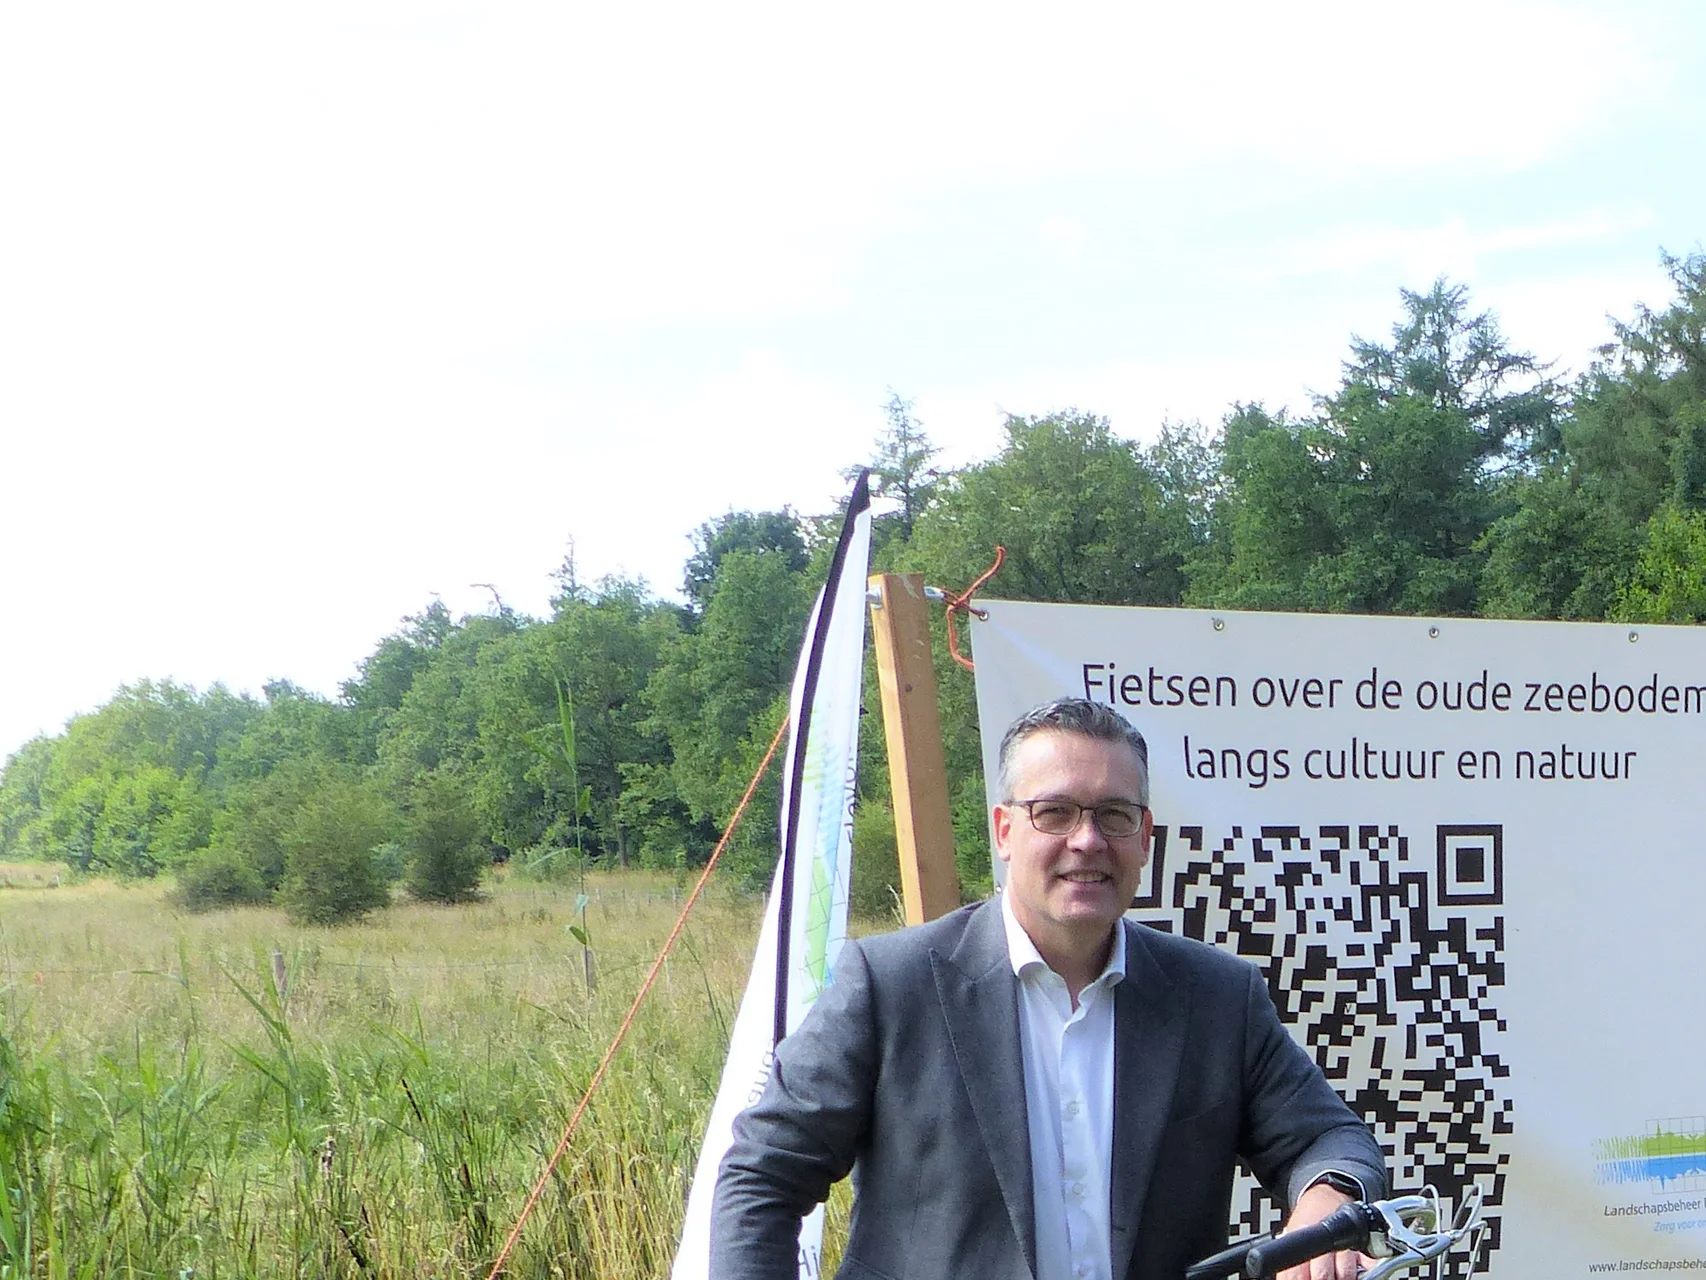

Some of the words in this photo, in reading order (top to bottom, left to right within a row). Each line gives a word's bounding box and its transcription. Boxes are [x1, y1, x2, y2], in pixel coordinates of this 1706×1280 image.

[1082, 662, 1237, 707] Fietsen
[1251, 675, 1343, 709] over
[1355, 667, 1402, 710] de
[1415, 669, 1512, 711] oude
[1183, 735, 1290, 789] langs
[1304, 737, 1445, 780] cultuur
[1456, 750, 1501, 780] en
[1515, 744, 1637, 780] natuur
[1604, 1198, 1702, 1217] Landschapsbeheer
[1653, 1221, 1676, 1234] Zorg
[1677, 1219, 1696, 1229] voor
